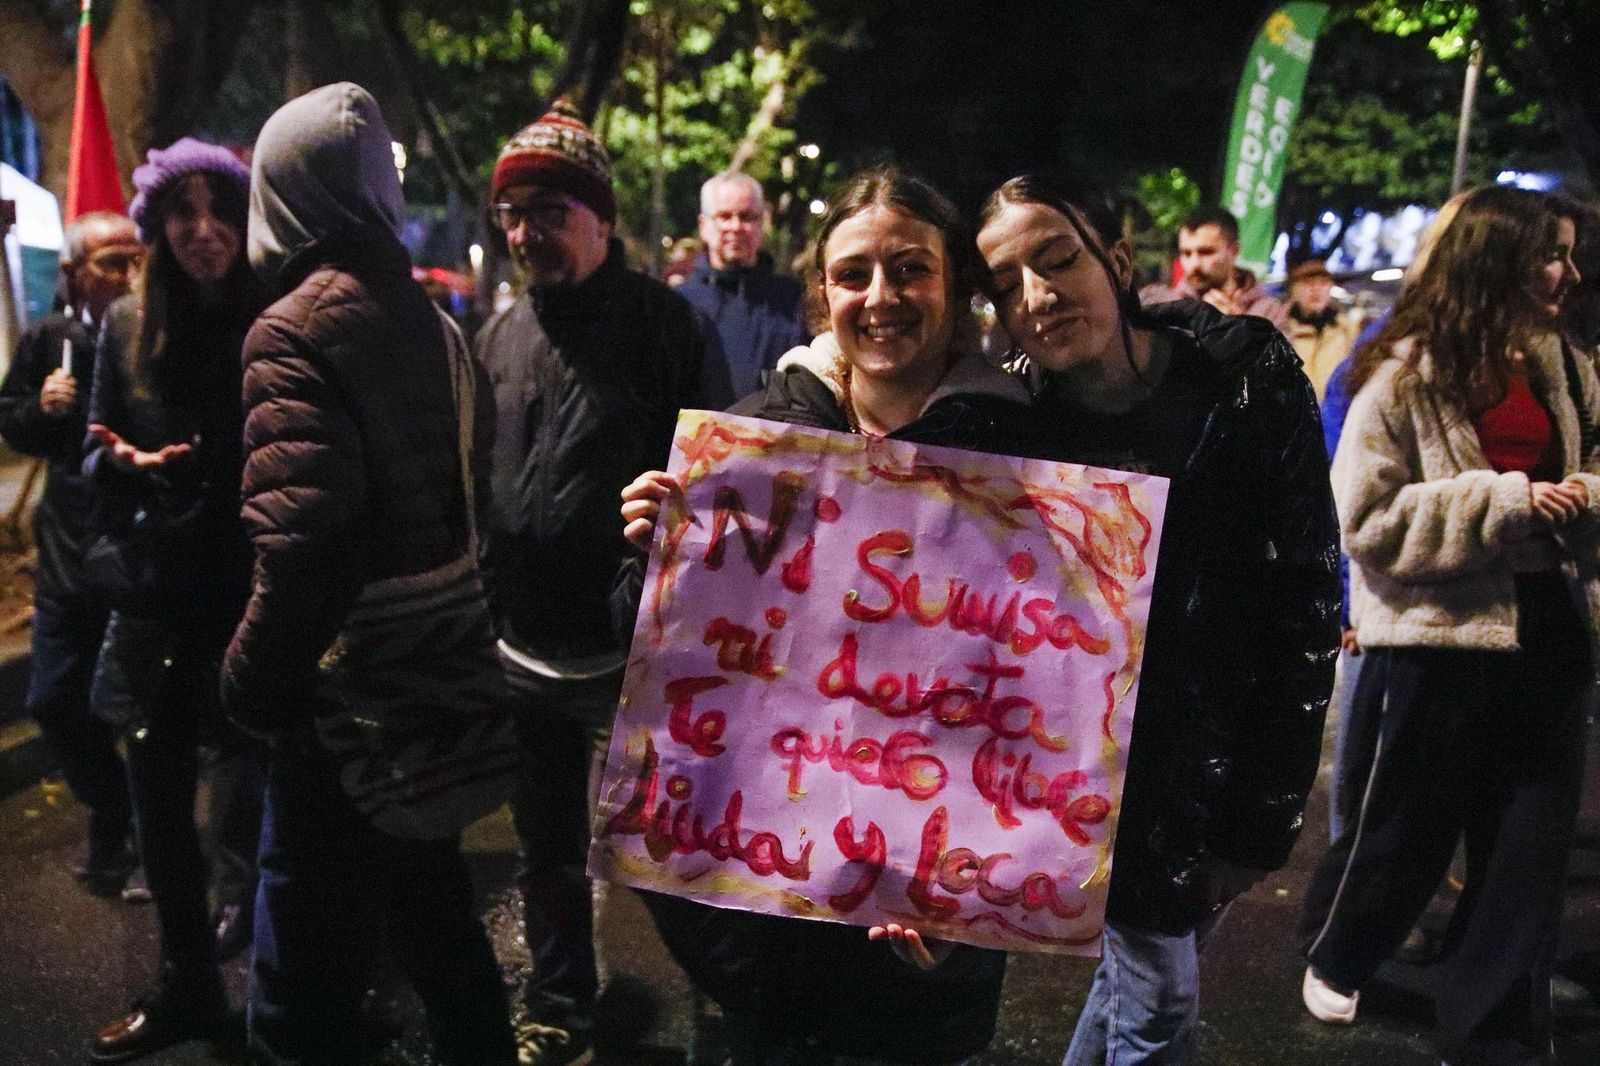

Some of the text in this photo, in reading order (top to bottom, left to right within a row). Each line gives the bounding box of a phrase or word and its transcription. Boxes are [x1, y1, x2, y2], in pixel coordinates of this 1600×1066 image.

[704, 470, 841, 594] Ni
[817, 632, 1069, 753] devota
[771, 718, 948, 802] quiero
[827, 815, 887, 913] y
